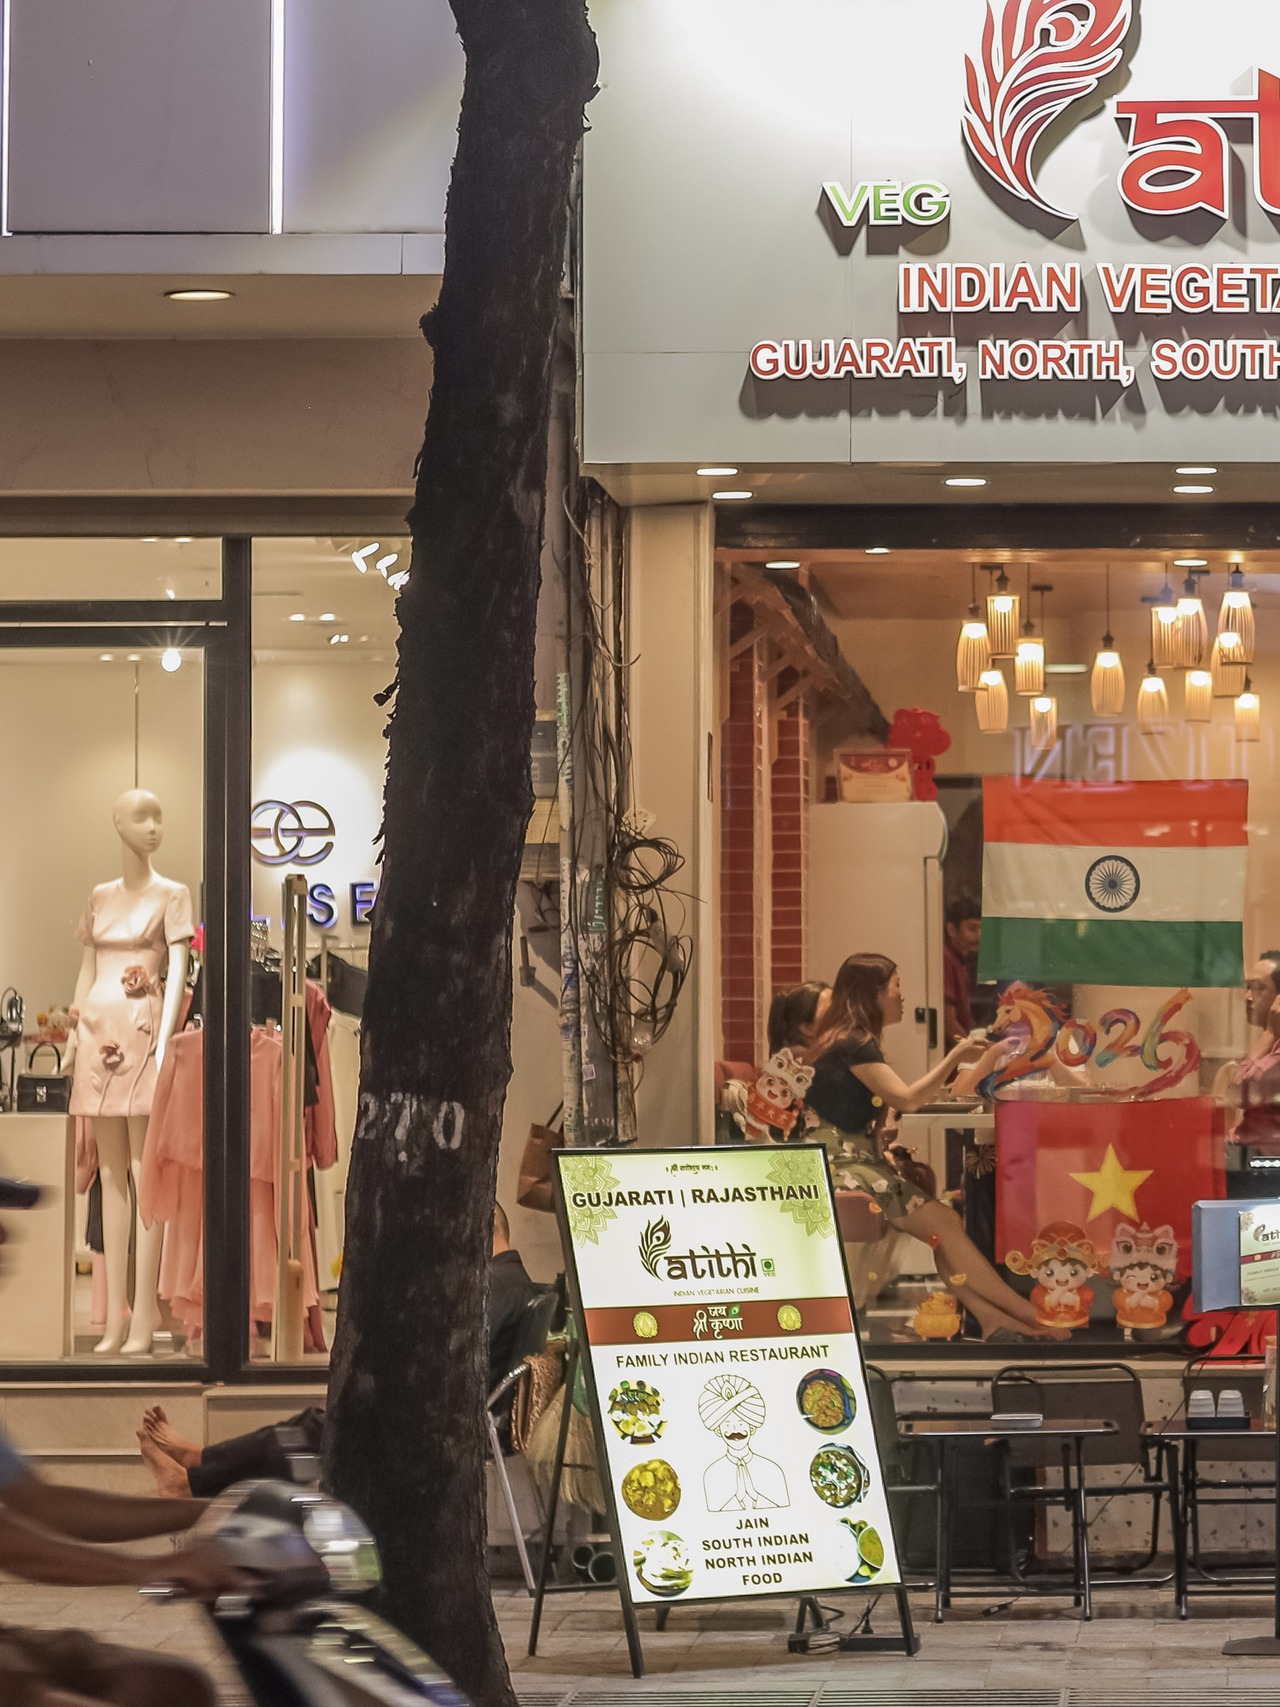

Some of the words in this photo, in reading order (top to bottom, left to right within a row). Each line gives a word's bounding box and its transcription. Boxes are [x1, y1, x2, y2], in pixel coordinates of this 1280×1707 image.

[822, 180, 951, 227] VEG
[899, 262, 1081, 314] INDIAN
[749, 337, 967, 385] GUJARATI,
[979, 339, 1134, 388] NORTH,
[973, 986, 1201, 1101] 2026
[571, 1189, 675, 1208] GUJARATI
[691, 1184, 820, 1204] RAJASTHANI
[663, 1241, 758, 1280] atithi
[673, 1289, 695, 1297] INDIAN
[697, 1287, 735, 1296] VEGETARIAN
[736, 1286, 760, 1294] CUISINE
[615, 1353, 669, 1368] FAMILY
[673, 1350, 725, 1365] INDIAN
[729, 1344, 830, 1363] RESTAURANT
[735, 1517, 770, 1530] JAIN
[702, 1537, 753, 1551] SOUTH
[757, 1533, 810, 1547] INDIAN
[704, 1555, 757, 1570] NORTH
[761, 1551, 814, 1565] INDIAN
[742, 1572, 783, 1586] FOOD
